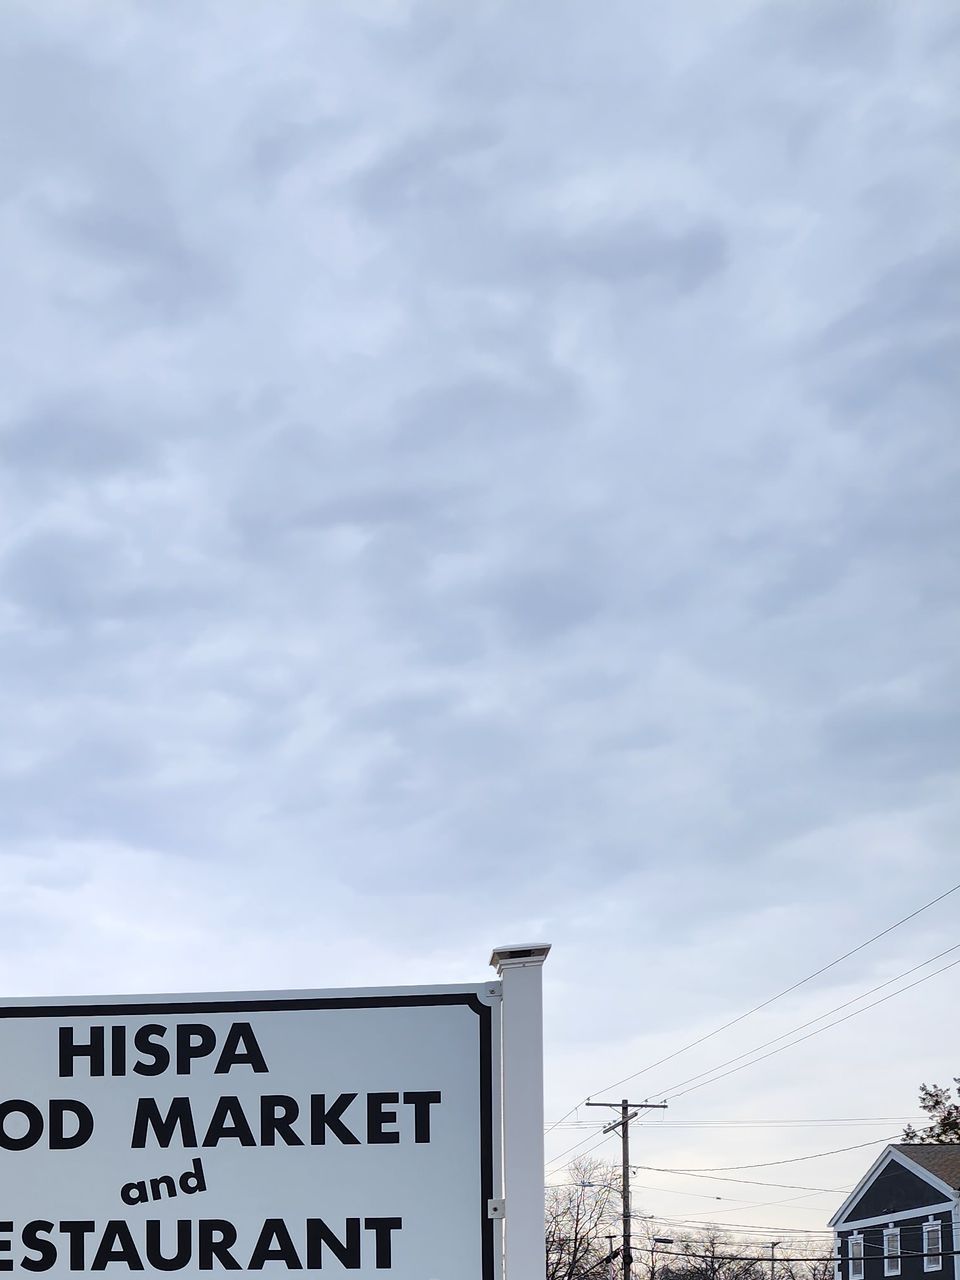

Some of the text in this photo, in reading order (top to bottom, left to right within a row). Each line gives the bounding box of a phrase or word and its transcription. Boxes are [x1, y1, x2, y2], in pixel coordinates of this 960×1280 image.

[59, 1022, 269, 1077] HISPA
[131, 1091, 441, 1148] MARKET
[121, 1158, 206, 1205] and
